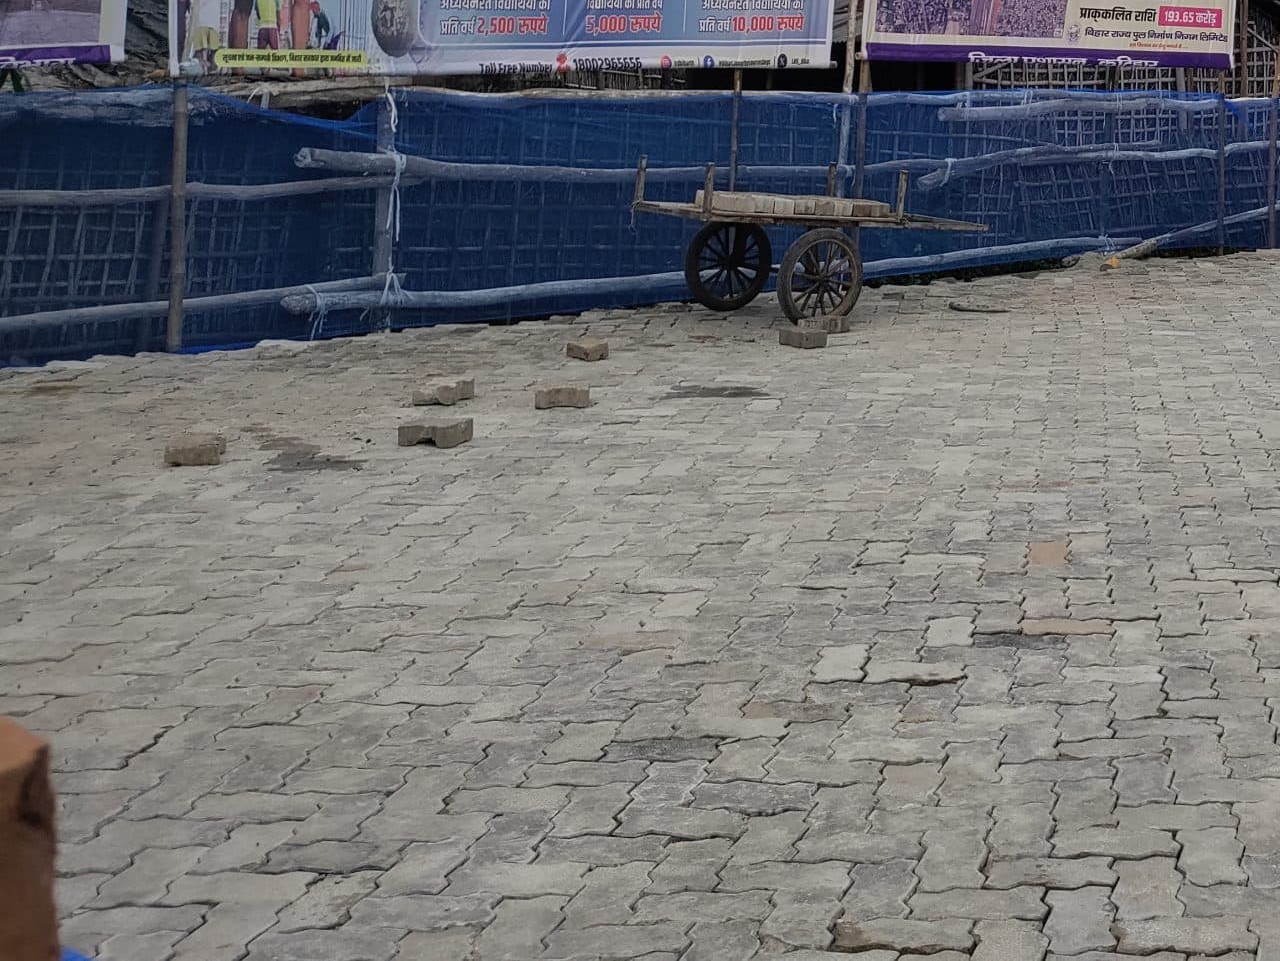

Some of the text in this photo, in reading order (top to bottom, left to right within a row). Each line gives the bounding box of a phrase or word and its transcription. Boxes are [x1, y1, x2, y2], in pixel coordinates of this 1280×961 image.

[440, 12, 549, 36] प्रति वर्ष 2,500 रुपये
[585, 11, 662, 37] 5,000 रुपये
[698, 12, 805, 34] प्रति वर्ष 10,000 रुपये
[1080, 6, 1217, 26] प्राक्कलित राशि 193.65 करोड़
[1085, 27, 1109, 38] बिहार
[1133, 29, 1146, 41] पुल
[479, 60, 553, 75] Toll Free Number
